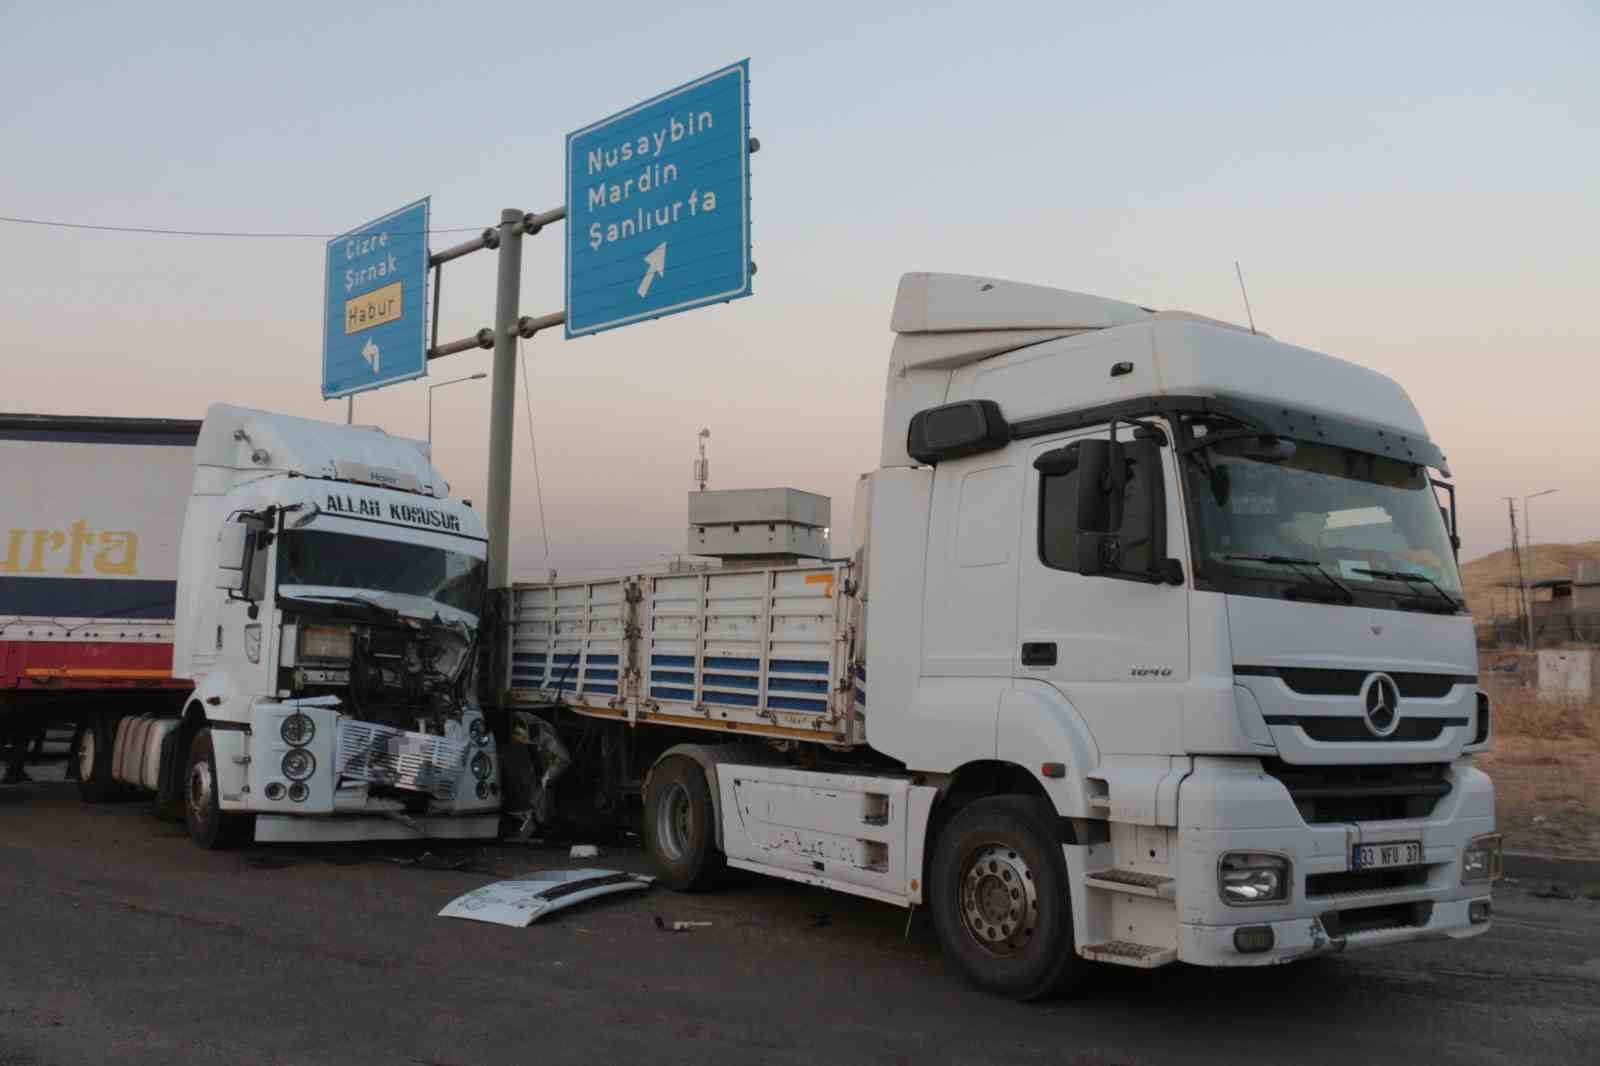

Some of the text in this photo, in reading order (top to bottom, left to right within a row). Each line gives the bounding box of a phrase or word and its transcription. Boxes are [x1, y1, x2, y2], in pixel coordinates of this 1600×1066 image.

[587, 111, 714, 175] Nusaybin
[588, 162, 678, 212] Mardin
[589, 188, 717, 251] Şanlıurfa
[345, 231, 389, 260] Cizre
[345, 252, 398, 292] Şırnak
[348, 296, 395, 326] Habur
[327, 494, 460, 531] ALLAH KORUSUN
[1360, 845, 1418, 866] 33 NFU 37
